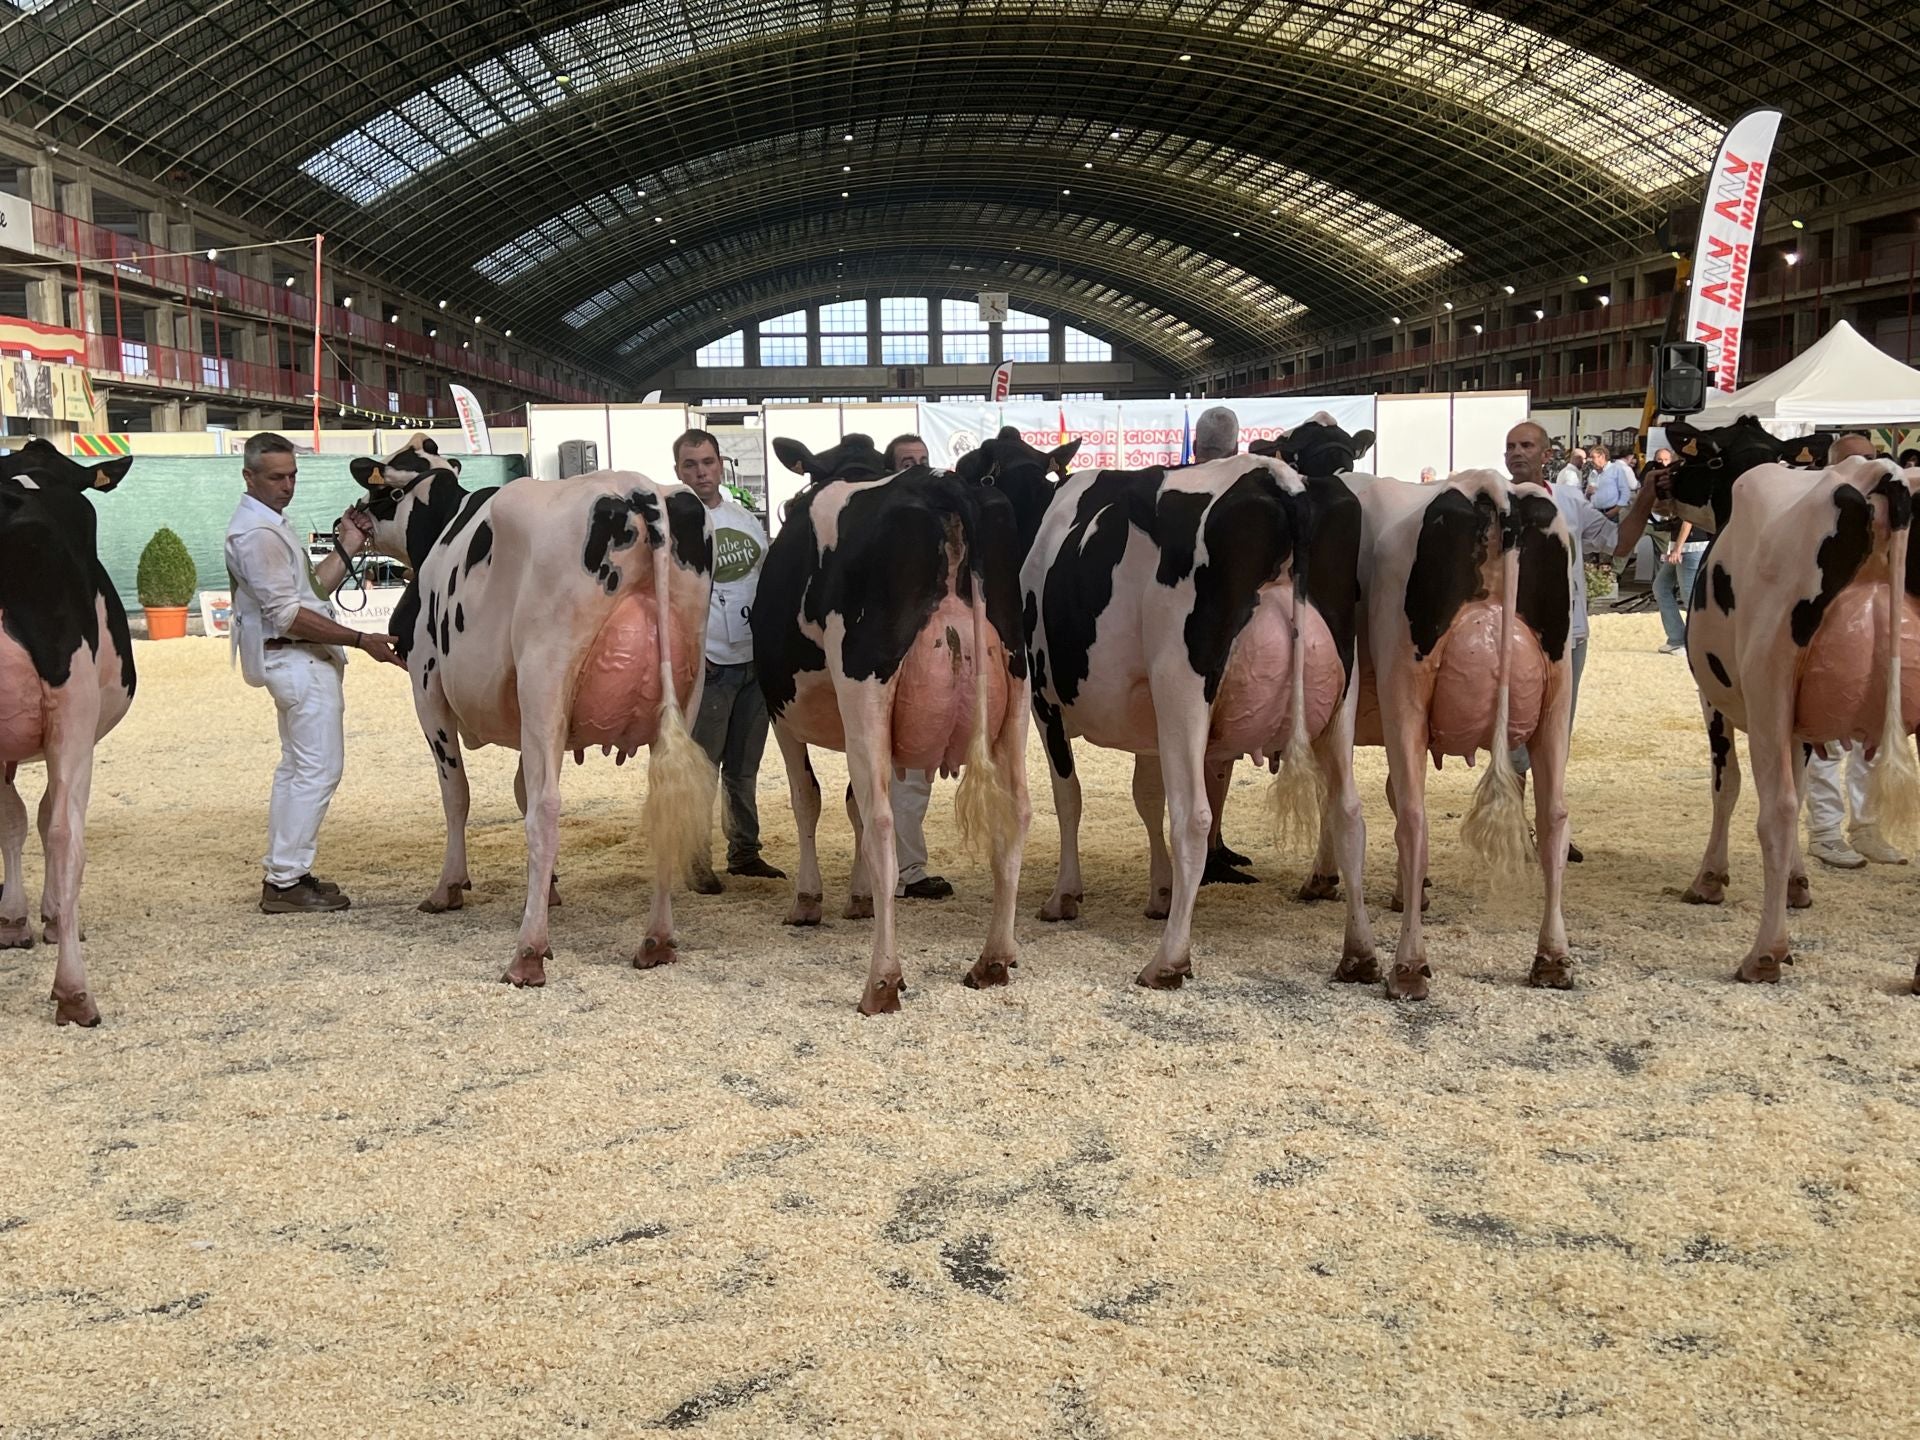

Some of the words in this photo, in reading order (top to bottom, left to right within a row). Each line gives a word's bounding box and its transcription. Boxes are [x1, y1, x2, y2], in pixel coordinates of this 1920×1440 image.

[1739, 161, 1764, 230] NANTA
[1727, 243, 1749, 312] NANTA
[1719, 326, 1739, 394] NANTA
[717, 537, 741, 554] abe
